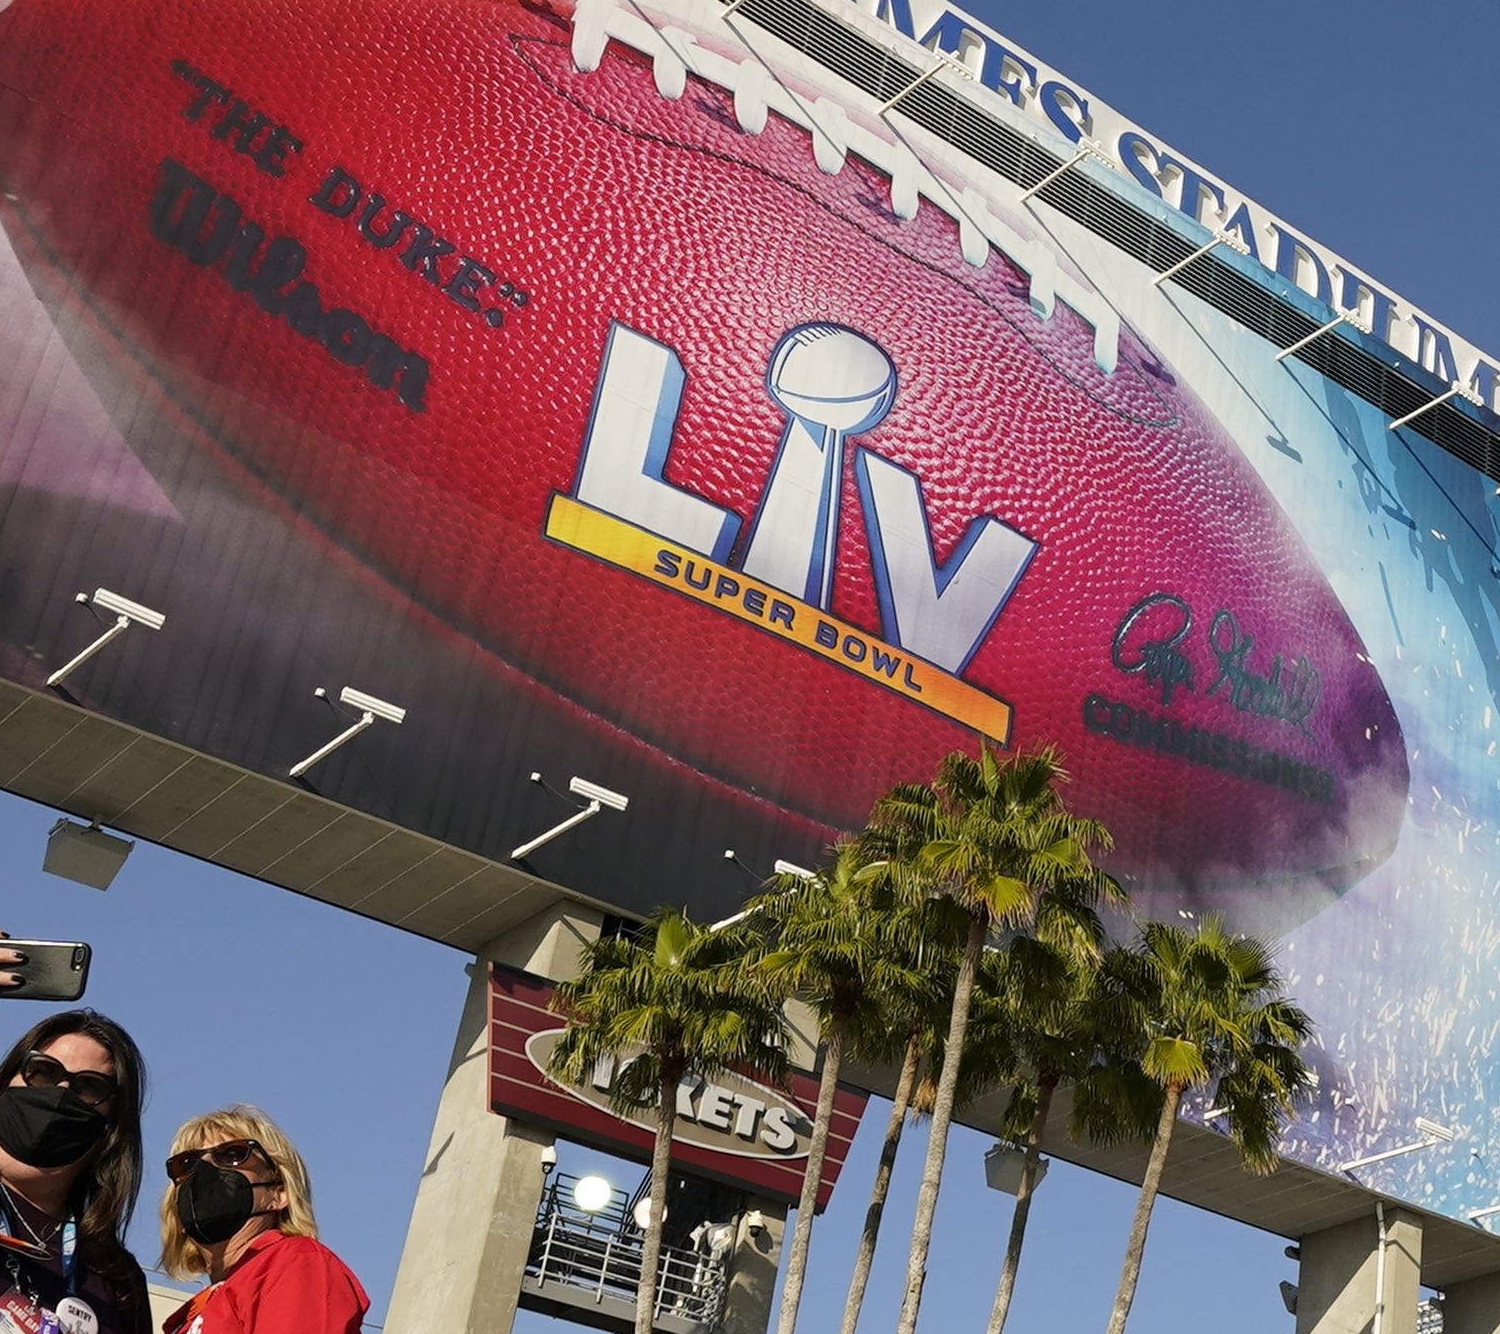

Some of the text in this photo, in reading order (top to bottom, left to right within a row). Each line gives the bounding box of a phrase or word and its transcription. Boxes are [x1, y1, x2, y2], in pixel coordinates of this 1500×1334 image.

[653, 548, 924, 694] SUPER BOWL
[67, 1304, 92, 1323] SENTRY
